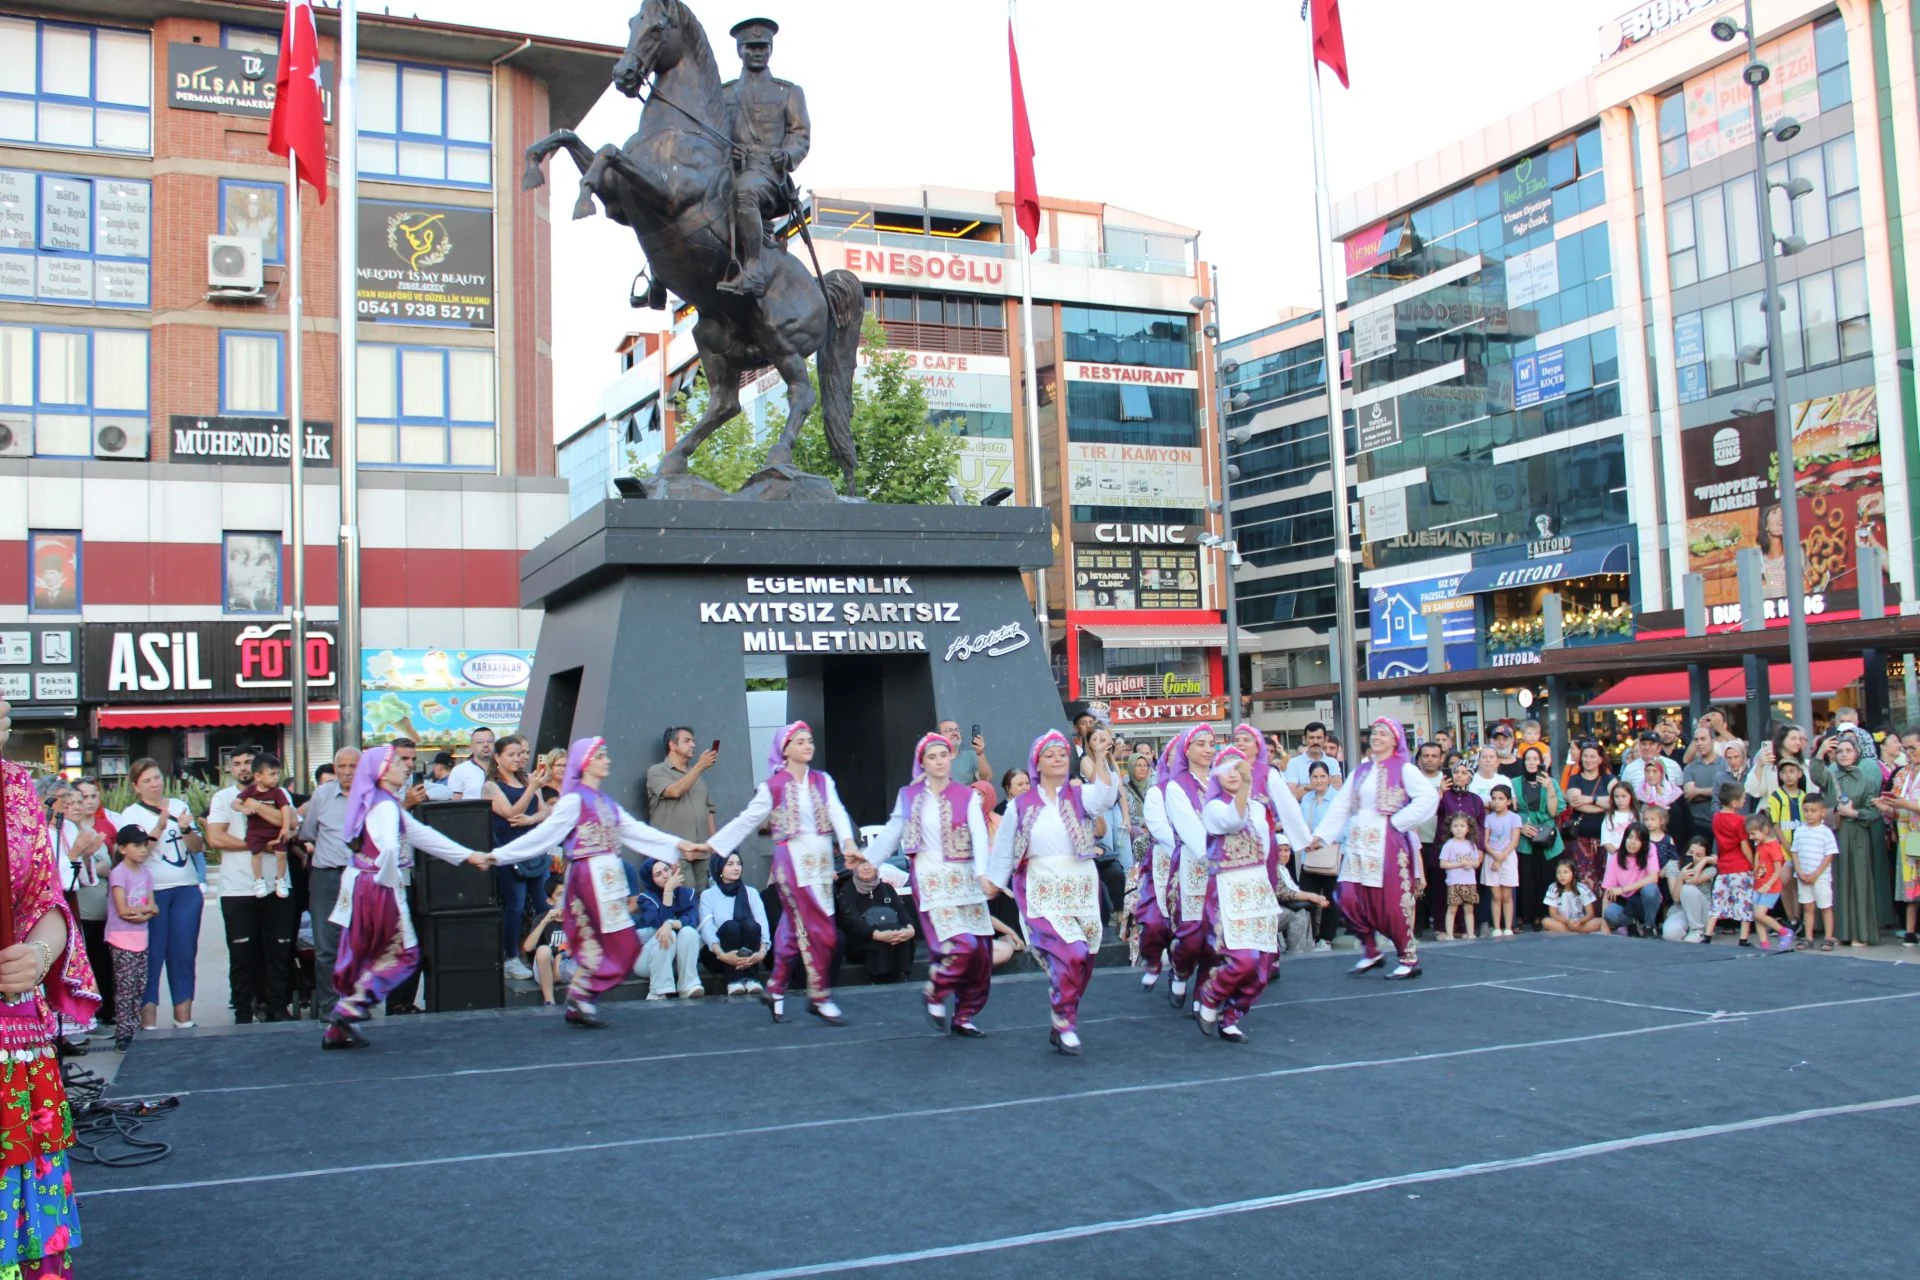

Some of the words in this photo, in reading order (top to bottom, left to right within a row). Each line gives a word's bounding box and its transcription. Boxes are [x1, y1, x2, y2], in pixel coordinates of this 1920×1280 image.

[176, 65, 256, 95] DİLŞAH
[176, 92, 235, 106] PERMANENT
[845, 248, 1003, 284] ENESOĞLU
[357, 267, 404, 280] MELODY
[440, 272, 486, 286] BEAUTY
[378, 290, 412, 301] KUAFÖRÜ
[414, 292, 424, 301] VE
[425, 293, 459, 303] GÜZELLİK
[461, 295, 490, 305] SALONU
[358, 300, 400, 315] 0541
[405, 303, 437, 317] 938
[440, 304, 462, 318] 52
[465, 306, 485, 320] 71
[923, 354, 968, 371] CAFE
[1079, 365, 1185, 384] RESTAURANT
[174, 421, 330, 460] MÜHENDİSİK
[1714, 437, 1740, 449] BURGER
[1080, 446, 1107, 459] TIR
[1122, 448, 1192, 463] KAMYON
[1715, 446, 1740, 461] KING
[1094, 524, 1186, 543] CLINIC
[1527, 537, 1571, 555] EATFORD
[1496, 563, 1563, 586] EATFORD
[1097, 580, 1124, 588] CLINIC
[700, 602, 835, 622] KAYITSIZ
[843, 602, 961, 625] ŞARTSIZ
[471, 662, 522, 672] KARKAYALAR
[1492, 653, 1534, 667] EATFORD
[40, 677, 73, 685] Teknik
[1093, 672, 1145, 697] Meydan
[1162, 672, 1201, 698] Çorba
[41, 687, 72, 696] Servis
[470, 702, 524, 712] KARKAYALA
[1117, 701, 1218, 720] KÖFTECİ
